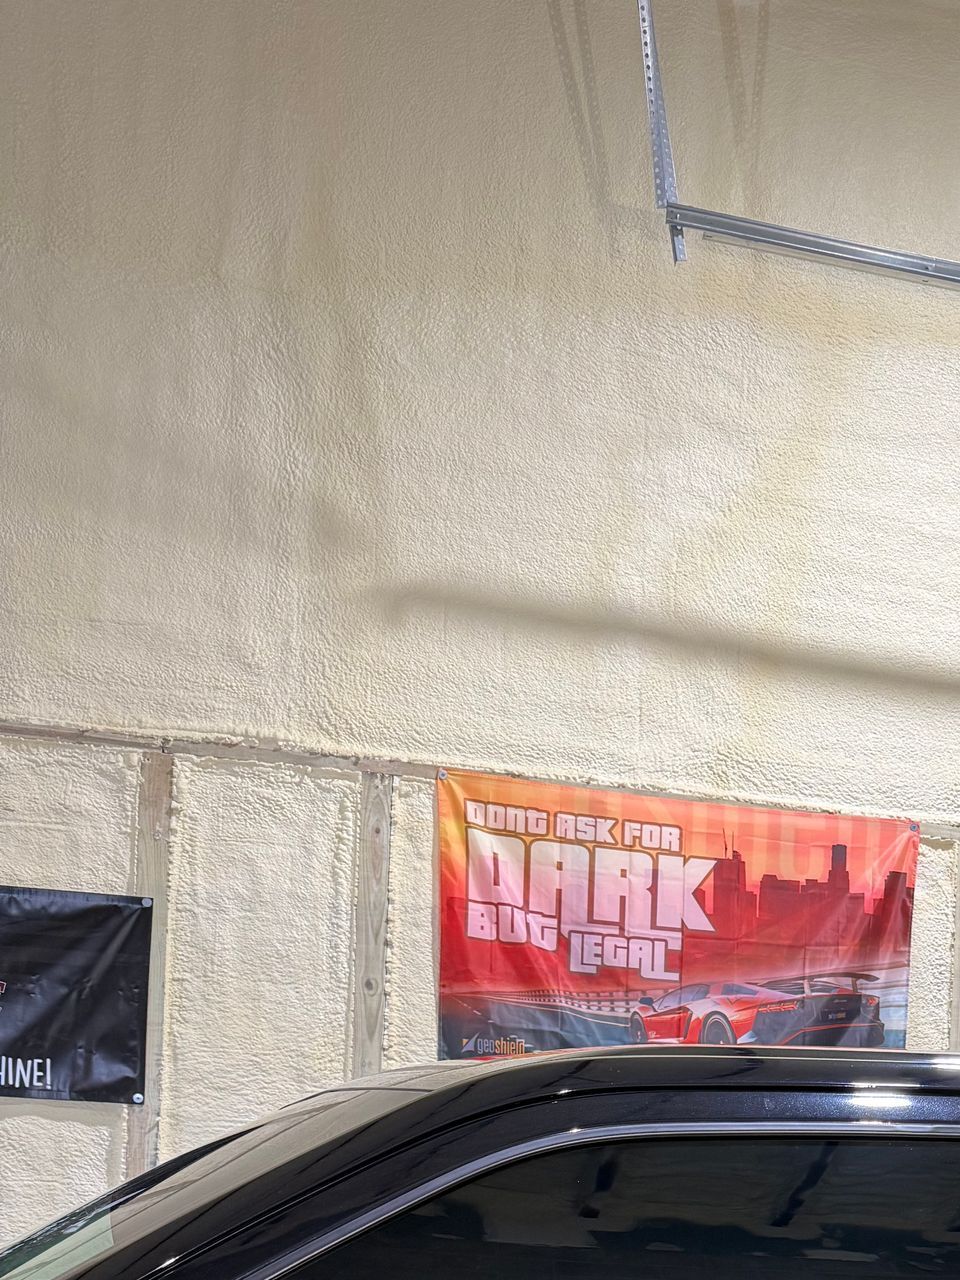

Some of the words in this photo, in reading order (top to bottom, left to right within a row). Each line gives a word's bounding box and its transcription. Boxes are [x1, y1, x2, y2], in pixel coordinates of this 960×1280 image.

[466, 799, 548, 834] DONT
[555, 813, 618, 845] ASK
[623, 821, 680, 851] FOR
[466, 827, 718, 950] DARK
[467, 901, 558, 951] BUT
[569, 931, 680, 981] LEGAL
